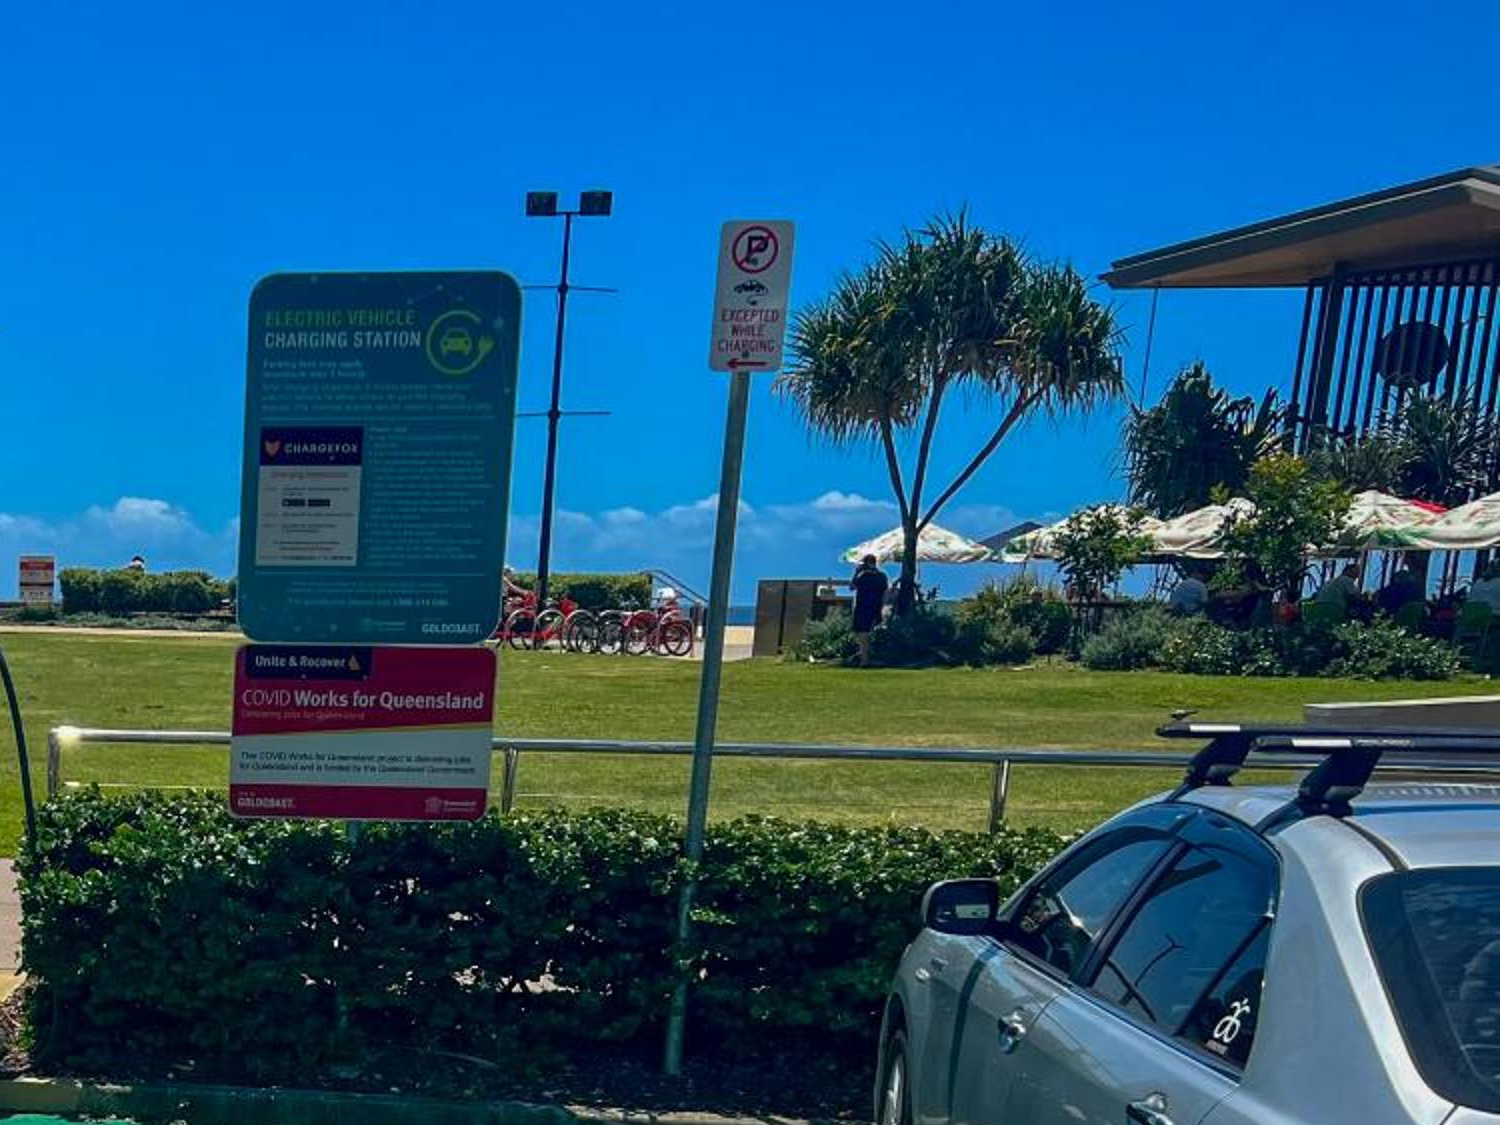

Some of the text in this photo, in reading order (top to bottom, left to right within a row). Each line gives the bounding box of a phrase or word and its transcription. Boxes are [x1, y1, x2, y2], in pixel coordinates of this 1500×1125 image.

[265, 308, 416, 326] ELECTRIC VEHICLE
[722, 310, 779, 322] EXCEPTED
[732, 325, 764, 336] WHILE
[265, 330, 421, 348] CHARGING STATION
[718, 340, 775, 352] CHARGING
[285, 442, 357, 454] CHARGEFOX
[255, 655, 345, 669] Unite & Recover
[243, 689, 484, 710] COVID Works for Queensland
